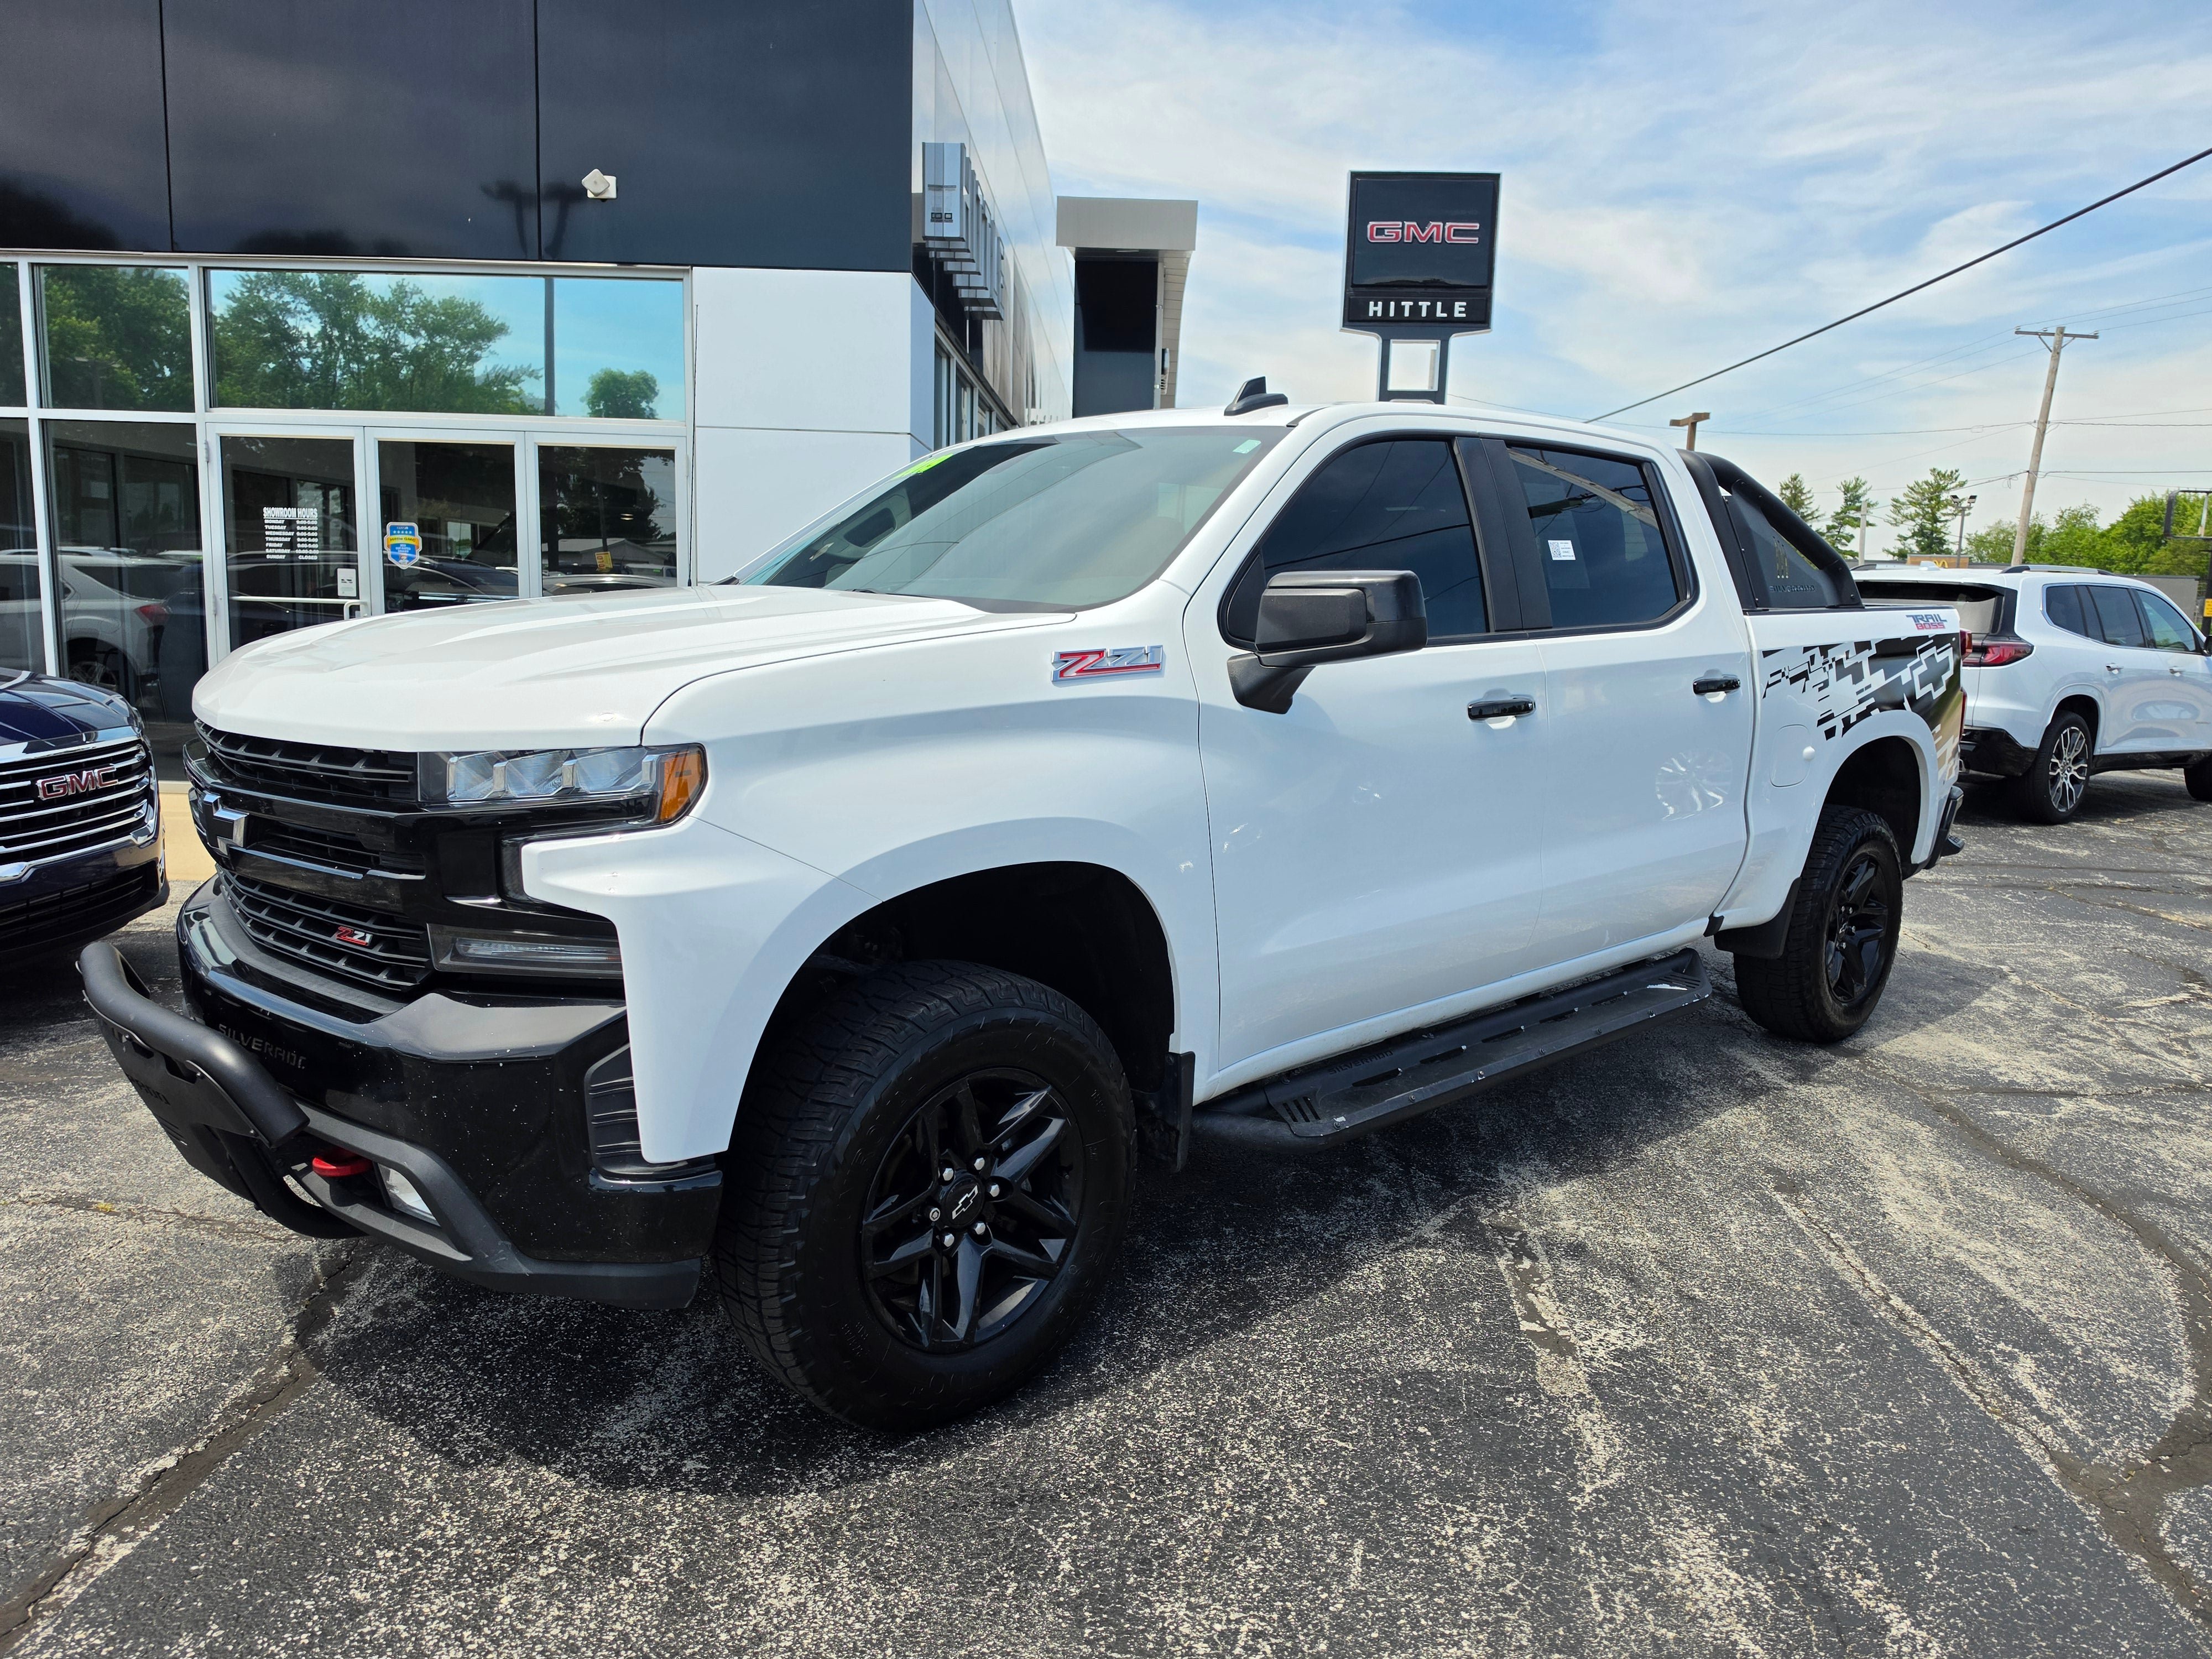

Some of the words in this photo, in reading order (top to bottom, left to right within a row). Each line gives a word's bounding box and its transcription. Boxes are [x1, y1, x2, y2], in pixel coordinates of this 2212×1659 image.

[1367, 221, 1479, 243] GMC
[1369, 301, 1466, 317] HITTLE
[263, 507, 297, 518] SHOWROOM
[297, 508, 318, 518] HOURS
[1906, 614, 1948, 623] TRAIL
[1916, 622, 1946, 630] BOSS
[1051, 645, 1163, 682] Z71
[36, 765, 118, 801] GMC
[336, 926, 373, 946] Z71
[1328, 1050, 1394, 1075] SILVERADO
